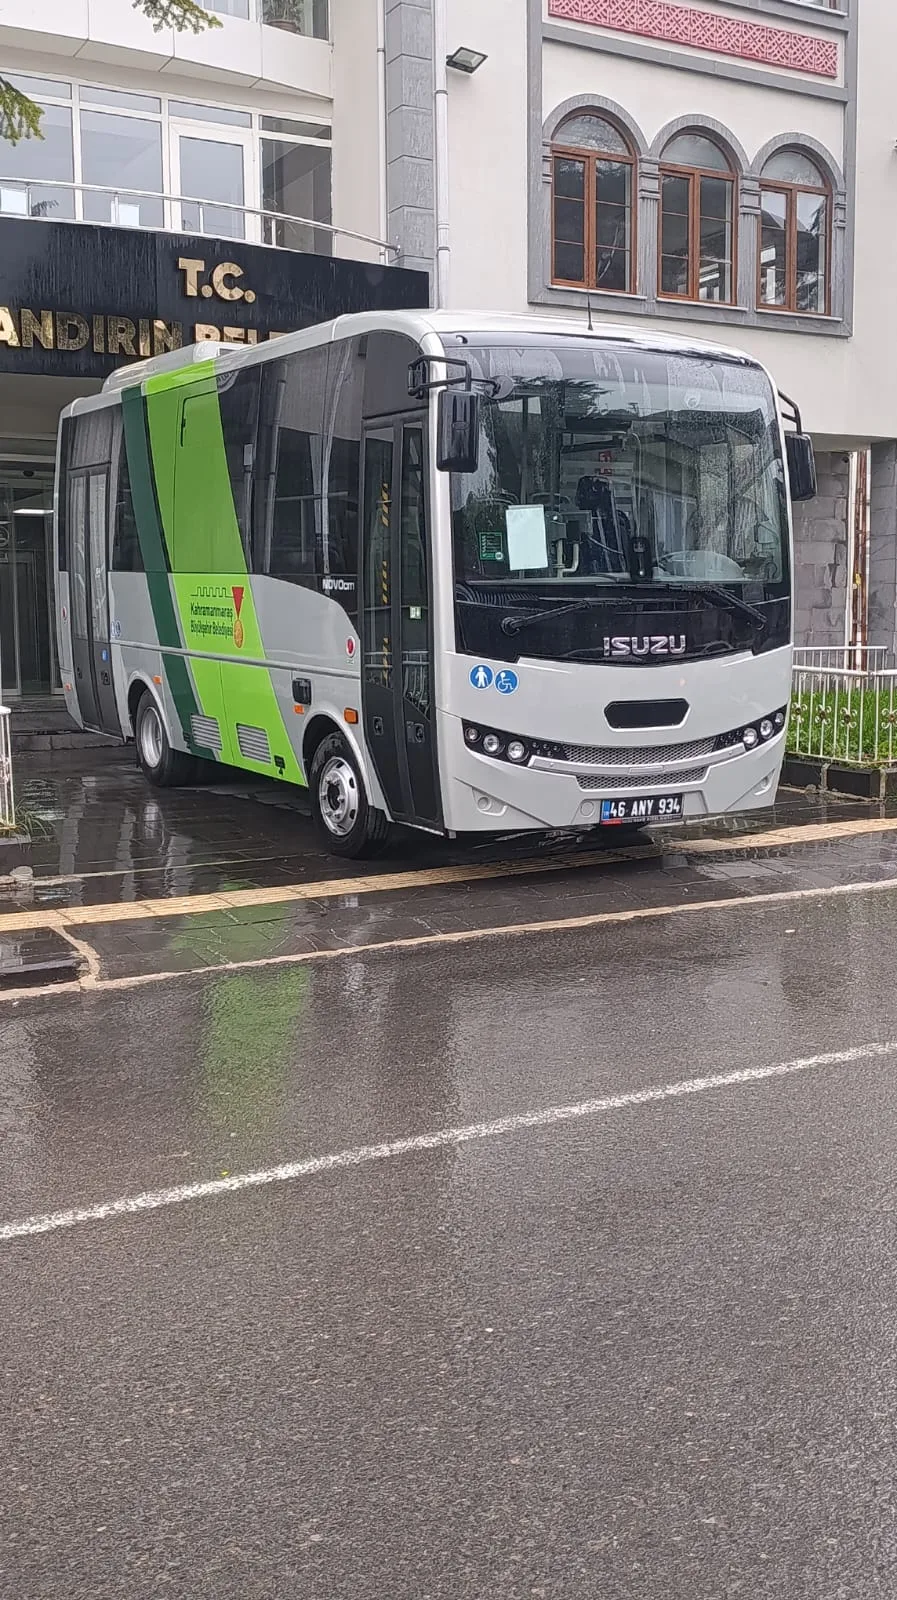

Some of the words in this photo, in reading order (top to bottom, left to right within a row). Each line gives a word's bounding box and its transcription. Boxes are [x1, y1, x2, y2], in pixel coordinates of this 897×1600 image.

[179, 257, 256, 303] T.C.
[0, 306, 183, 357] ANDIRIN
[603, 634, 686, 656] ISUZU
[610, 801, 626, 817] 46
[631, 799, 654, 816] ANY
[658, 797, 680, 814] 934
